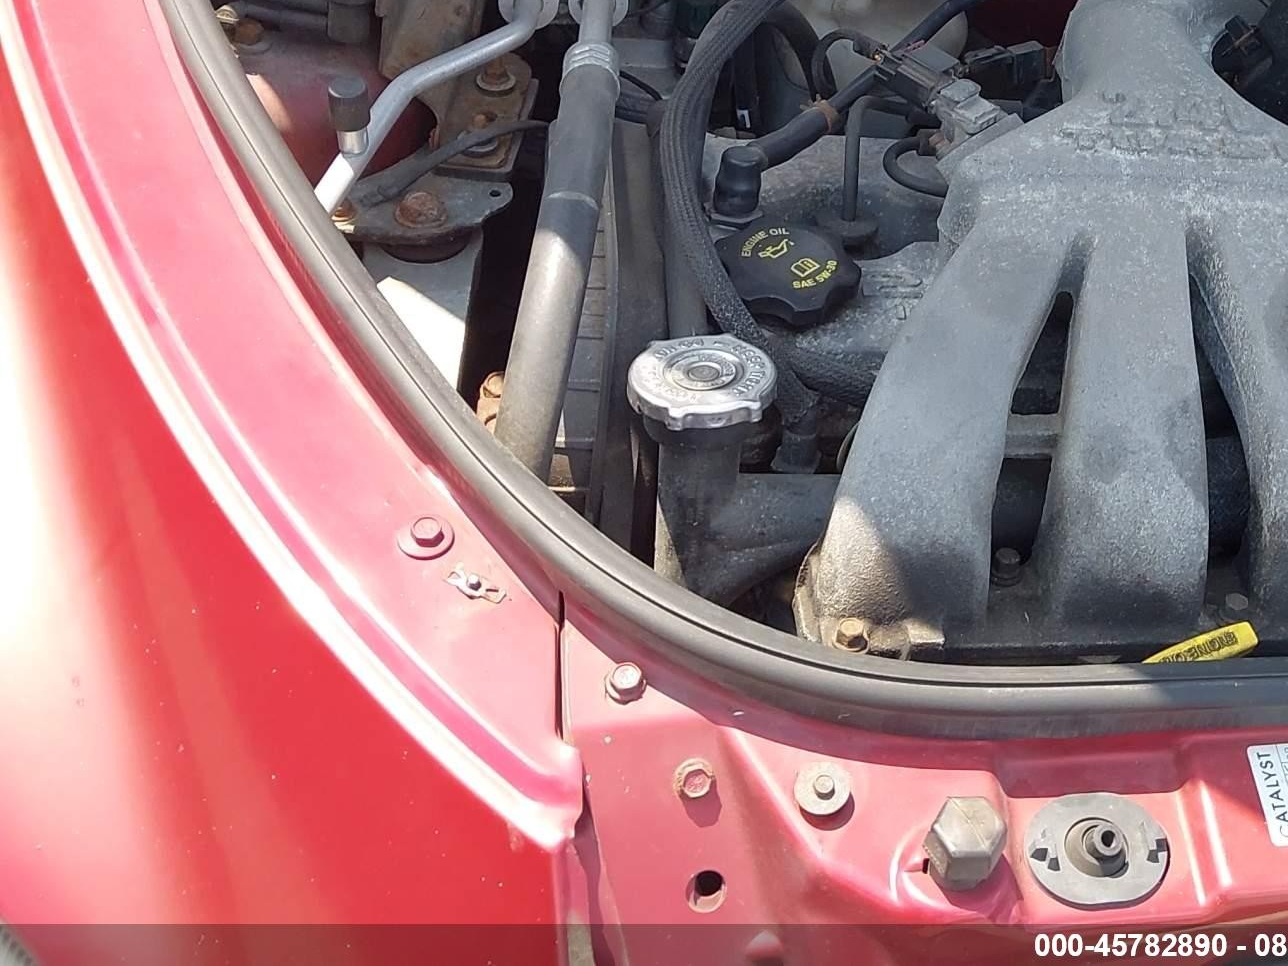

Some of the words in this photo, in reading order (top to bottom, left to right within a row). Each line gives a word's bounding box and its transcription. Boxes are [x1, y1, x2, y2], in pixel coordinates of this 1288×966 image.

[741, 230, 769, 257] ENGINE
[792, 278, 817, 289] SAE
[816, 260, 838, 283] 5W-30
